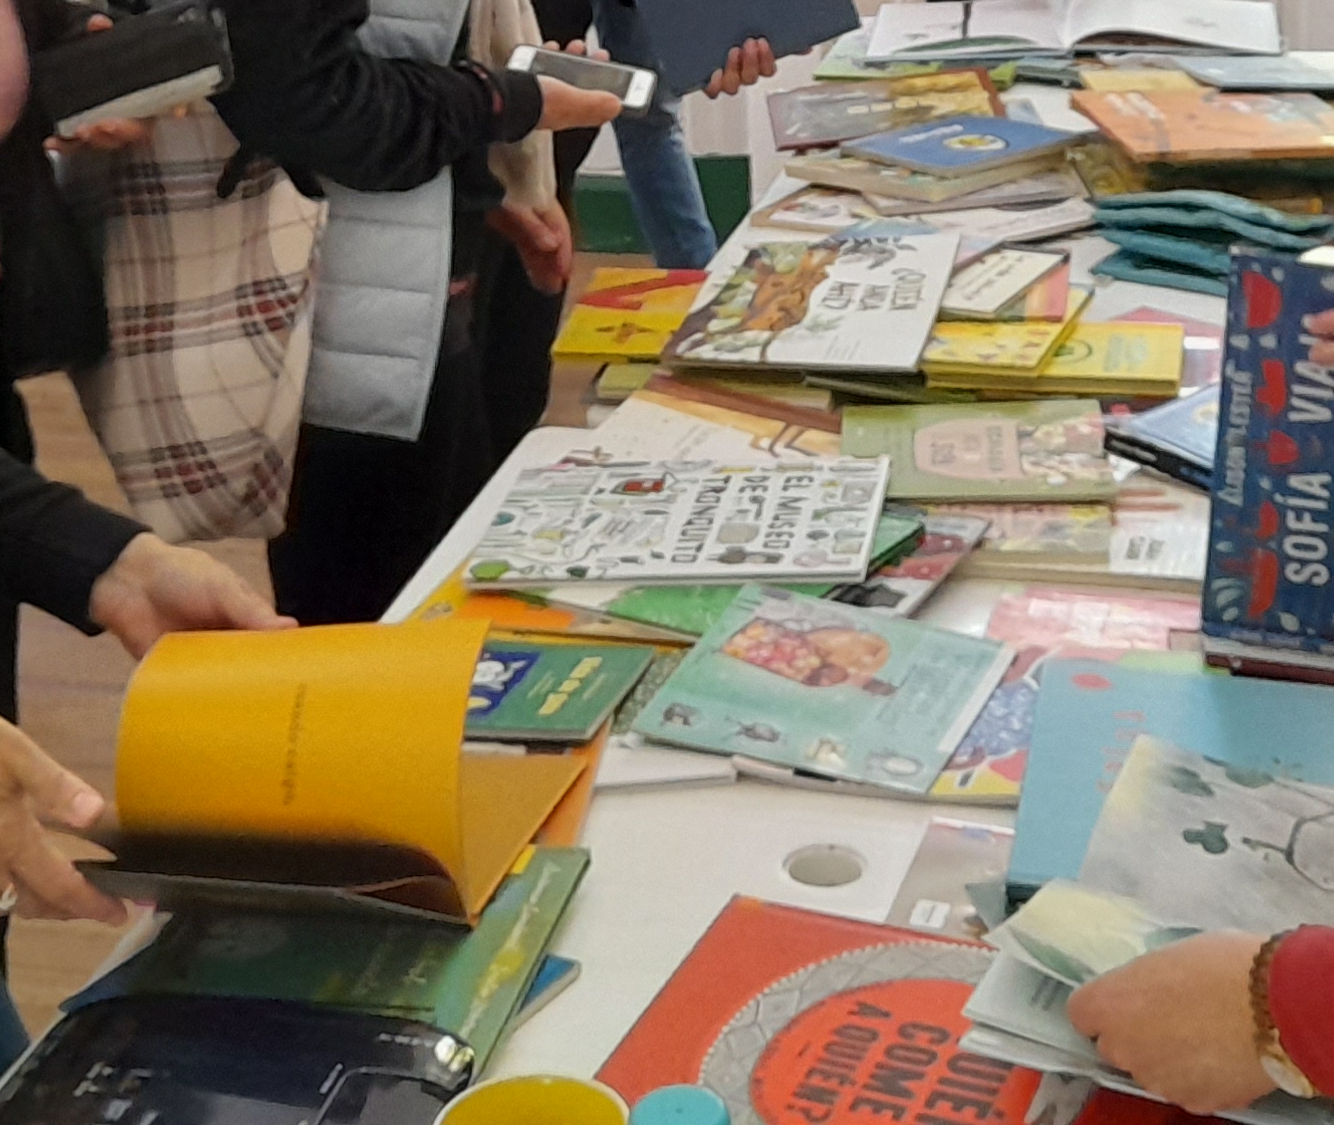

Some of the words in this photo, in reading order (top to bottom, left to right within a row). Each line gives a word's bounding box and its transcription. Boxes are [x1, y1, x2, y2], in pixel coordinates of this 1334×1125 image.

[738, 475, 771, 494] DE
[781, 475, 815, 491] EL
[762, 496, 809, 549] MUSEO
[1272, 471, 1332, 586] SOFÍA
[847, 1001, 892, 1019] A
[785, 1024, 880, 1124] QUIÉN?
[849, 1023, 951, 1122] COME
[915, 1049, 1016, 1125] UIÉ
